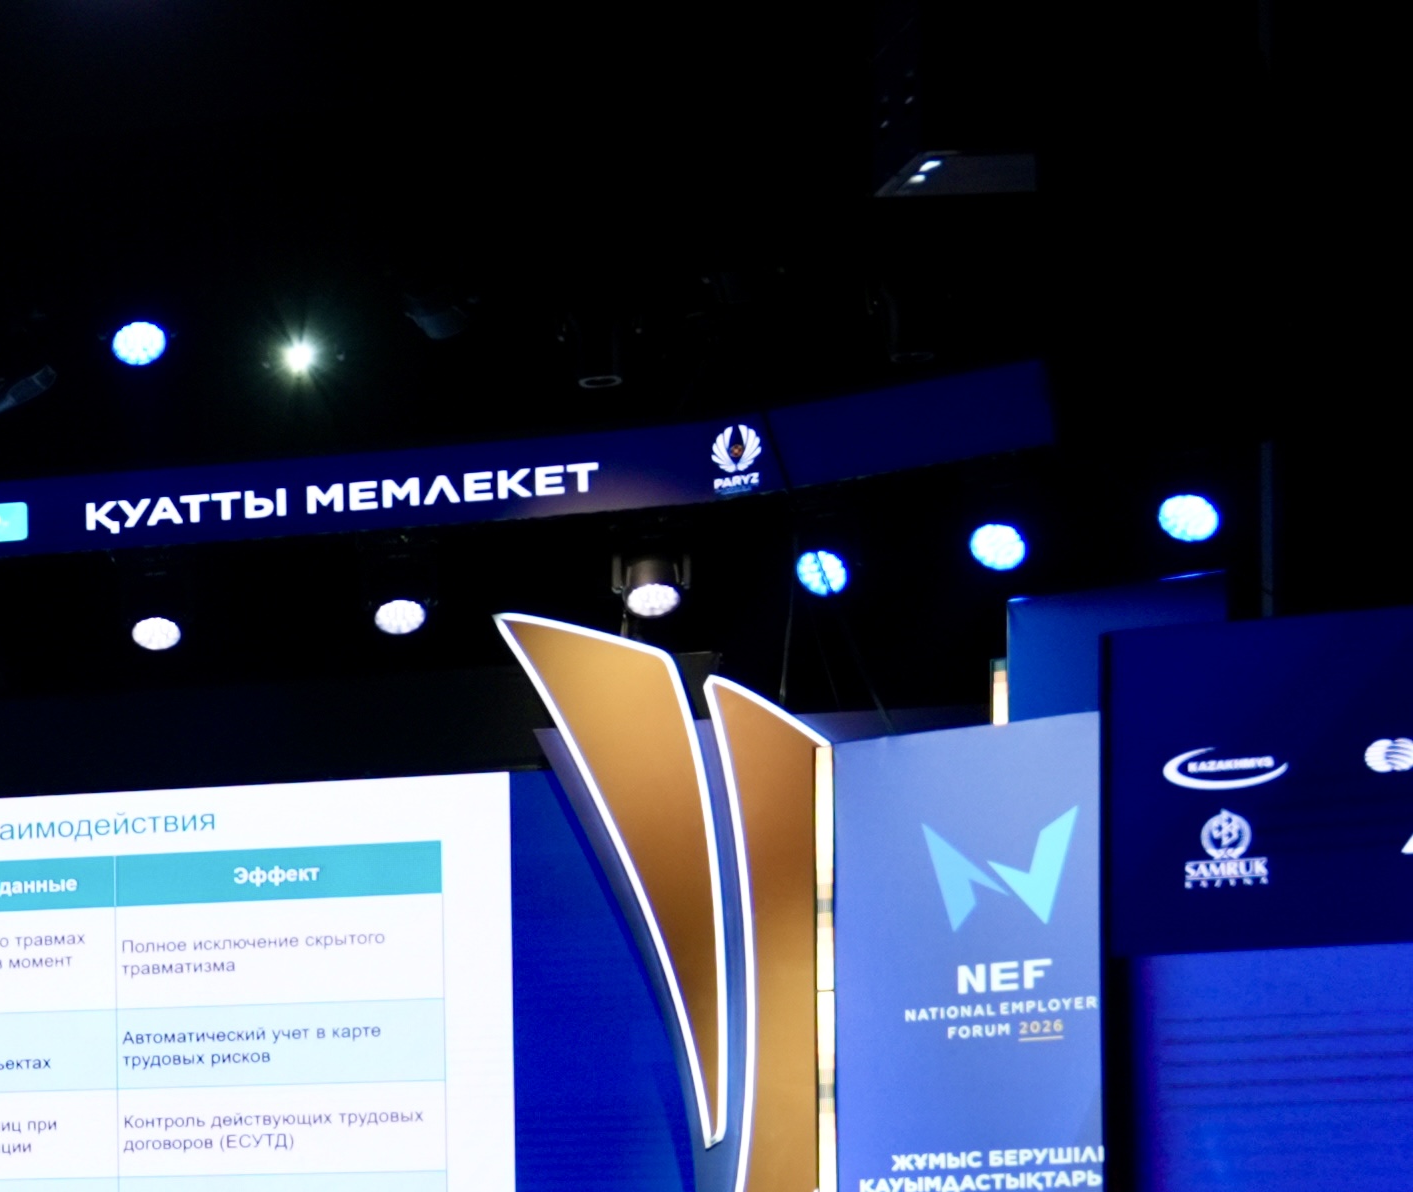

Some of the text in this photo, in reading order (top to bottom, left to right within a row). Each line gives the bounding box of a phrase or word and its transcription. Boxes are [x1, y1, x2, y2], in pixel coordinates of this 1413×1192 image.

[85, 462, 599, 534] ҚУАТТЫ МЕМЛЕКЕТ
[233, 866, 321, 887] Эффект
[1184, 860, 1268, 878] SAMRUK
[0, 937, 10, 949] о
[15, 933, 86, 950] травмах
[121, 932, 386, 954] Полное исключение скрытого
[9, 955, 73, 969] момент
[122, 960, 236, 978] травматизма
[956, 958, 1053, 995] NEF
[904, 1003, 996, 1022] NATIONAL
[122, 1024, 382, 1045] Автоматический учет в карте
[947, 1019, 1064, 1040] FORUM 2026
[122, 1051, 271, 1070] трудовых рисков
[27, 1118, 57, 1133] при
[124, 1110, 424, 1130] Контроль действующих трудовых
[123, 1133, 295, 1153] договоров (ЕСУТД)
[891, 1151, 983, 1172] ЖҰМЫС
